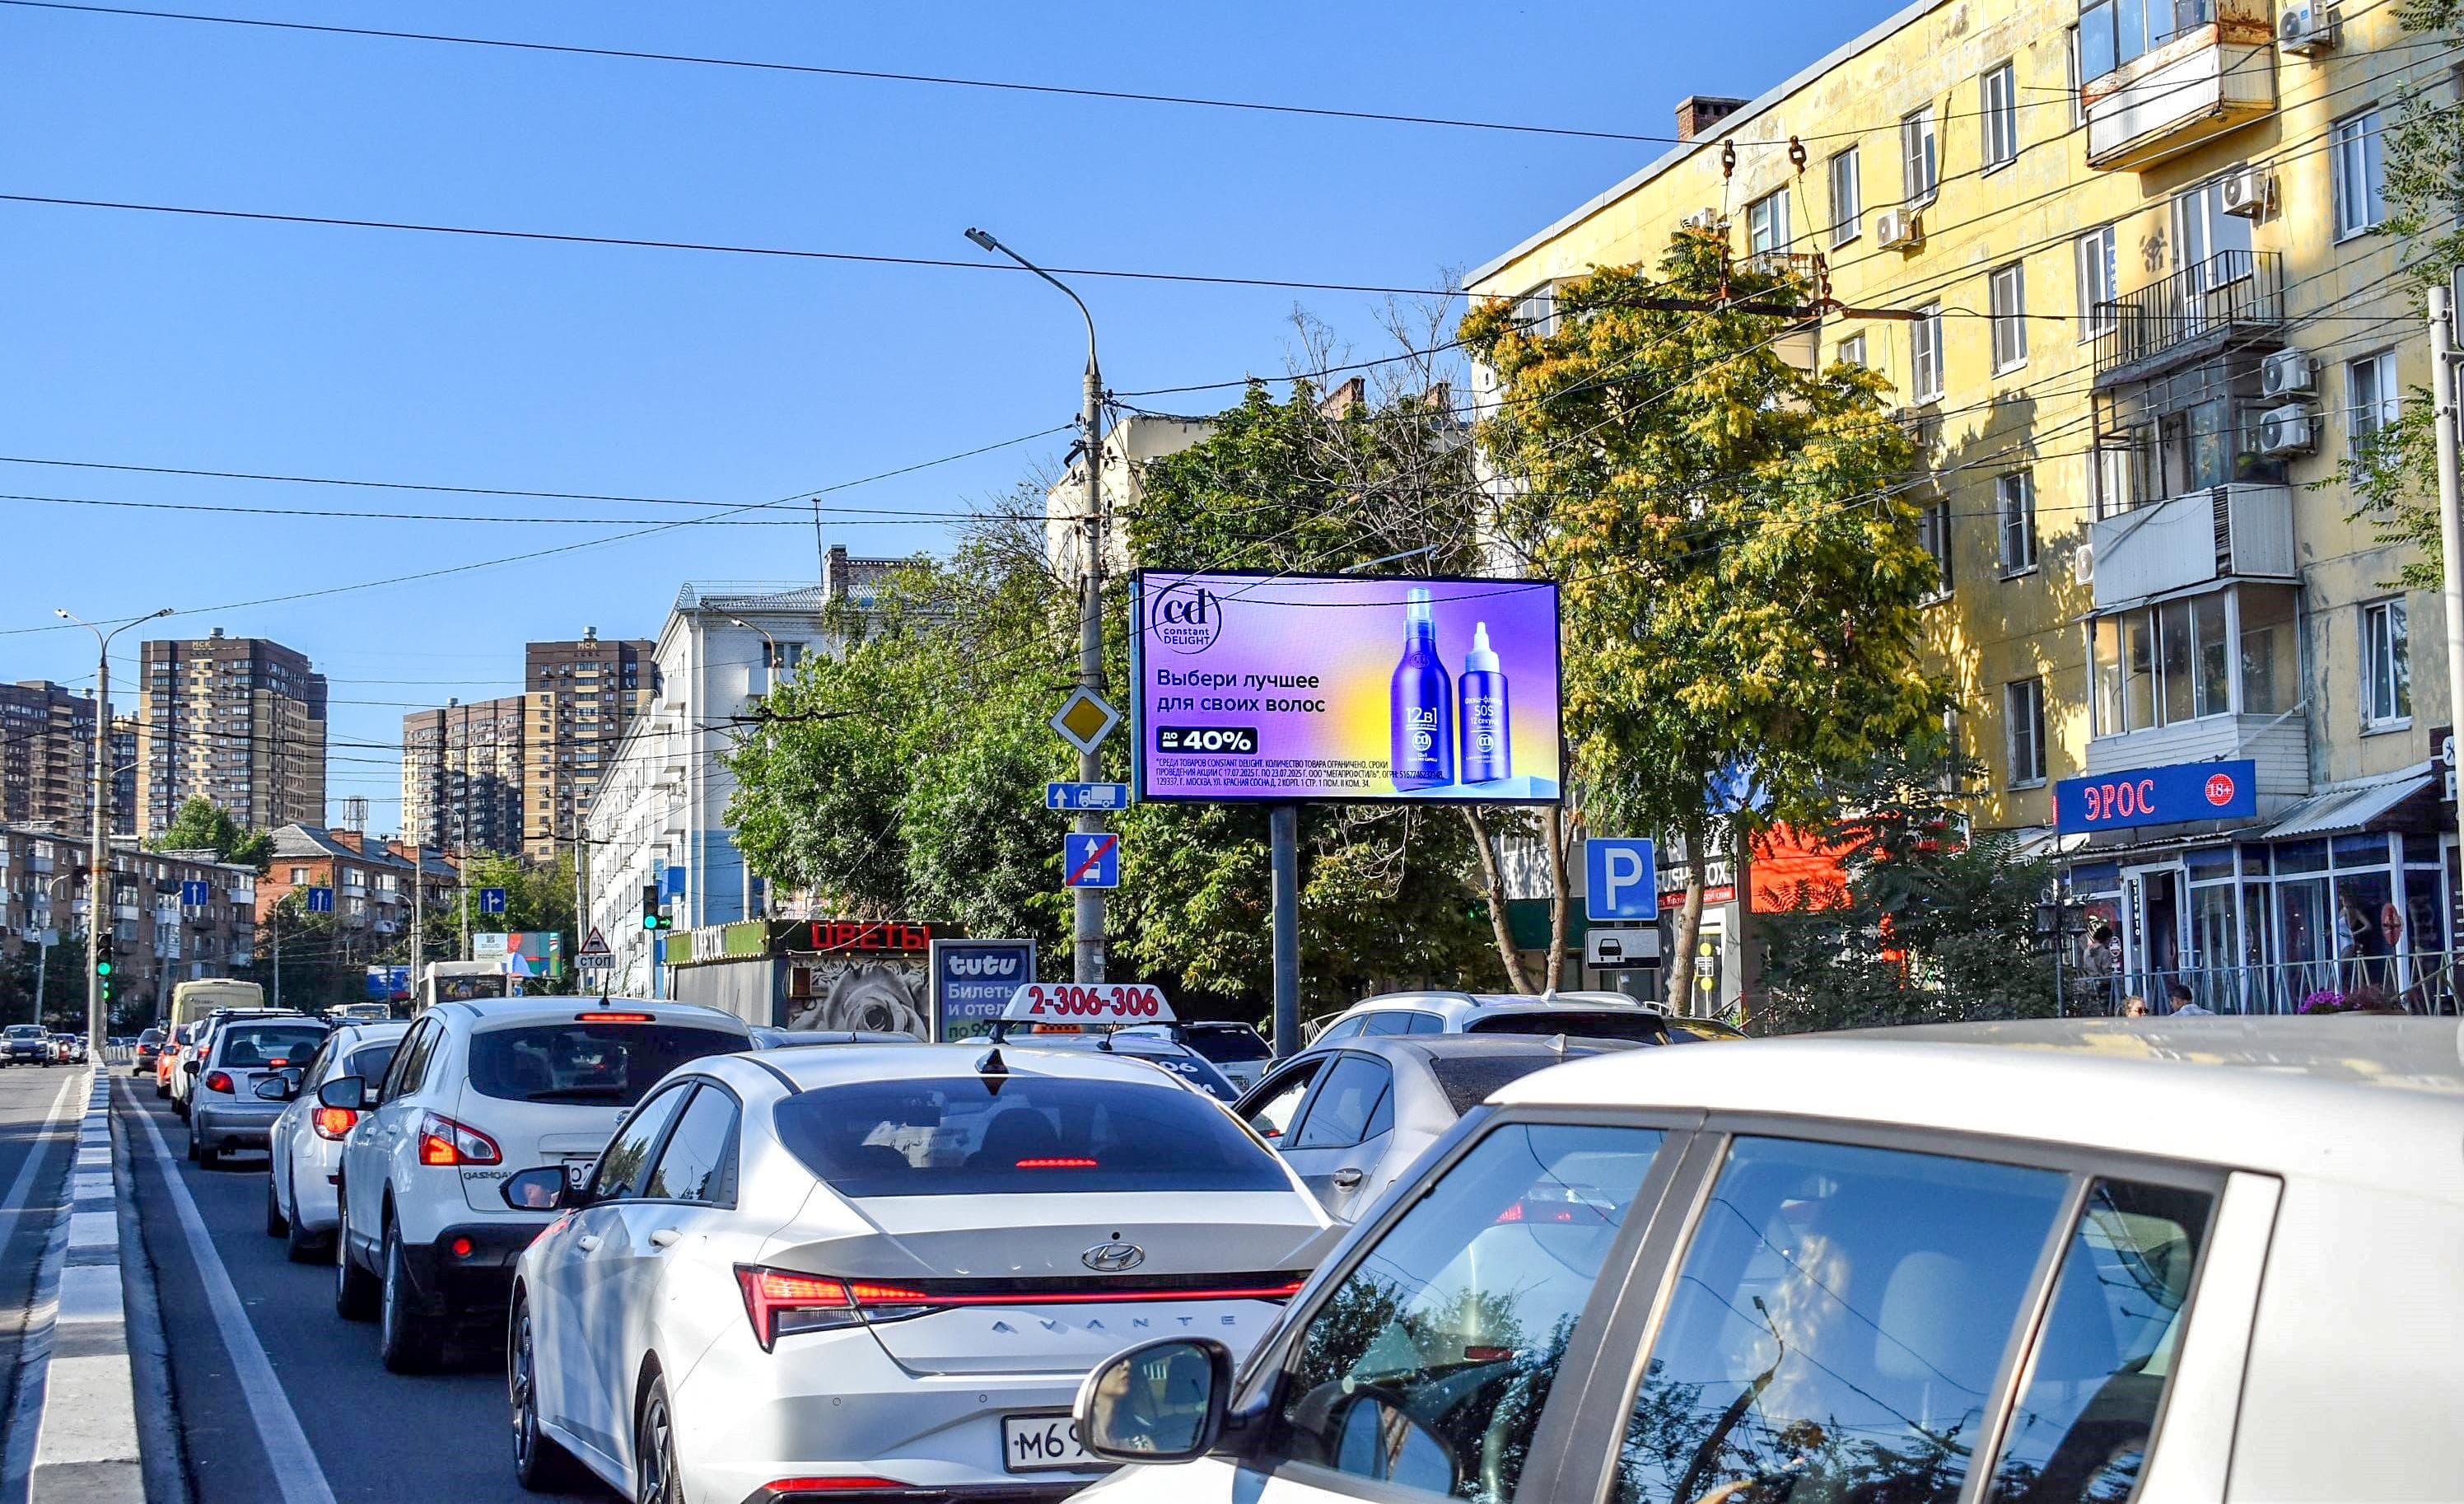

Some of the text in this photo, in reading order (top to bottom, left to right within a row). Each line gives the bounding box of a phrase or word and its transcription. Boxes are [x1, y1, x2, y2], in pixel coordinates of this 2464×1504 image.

[1164, 588, 1208, 624] cd
[1164, 628, 1210, 636] constant
[1164, 636, 1211, 645] DELIGHT
[1157, 669, 1319, 691] Выбери лучшее
[1157, 697, 1326, 712] для своих волос
[1474, 704, 1494, 717] SOS
[1162, 731, 1178, 740] до
[1180, 759, 1206, 768] ТОВАРОВ
[1207, 759, 1238, 768] CONSTANT
[1265, 759, 1304, 768] КОЛИЧЕСТВО
[1304, 759, 1327, 768] ТОВАРА
[1369, 760, 1388, 769] СРОКИ
[1156, 768, 1196, 778] ПРОВЕДЕНИЯ
[1197, 768, 1218, 778] АКЦИИ
[1224, 768, 1255, 777] 17.07.2025
[1309, 769, 1323, 778] ООО
[1224, 778, 1249, 787] КРАСНАЯ
[1250, 778, 1269, 787] СОСНА
[2084, 779, 2155, 821] ЭРОС
[2210, 782, 2232, 797] 18+
[1605, 848, 1643, 910] P
[1655, 862, 1727, 892] SUSH OX
[812, 922, 931, 952] ЦВЕТЫ
[580, 957, 611, 967] СТОП
[949, 955, 1017, 975] tutu
[948, 983, 1015, 999] Билеты
[1029, 985, 1159, 1016] 2-306-306
[949, 1004, 1006, 1016] и отел
[949, 1026, 968, 1039] по
[992, 1315, 1235, 1332] AVANTE
